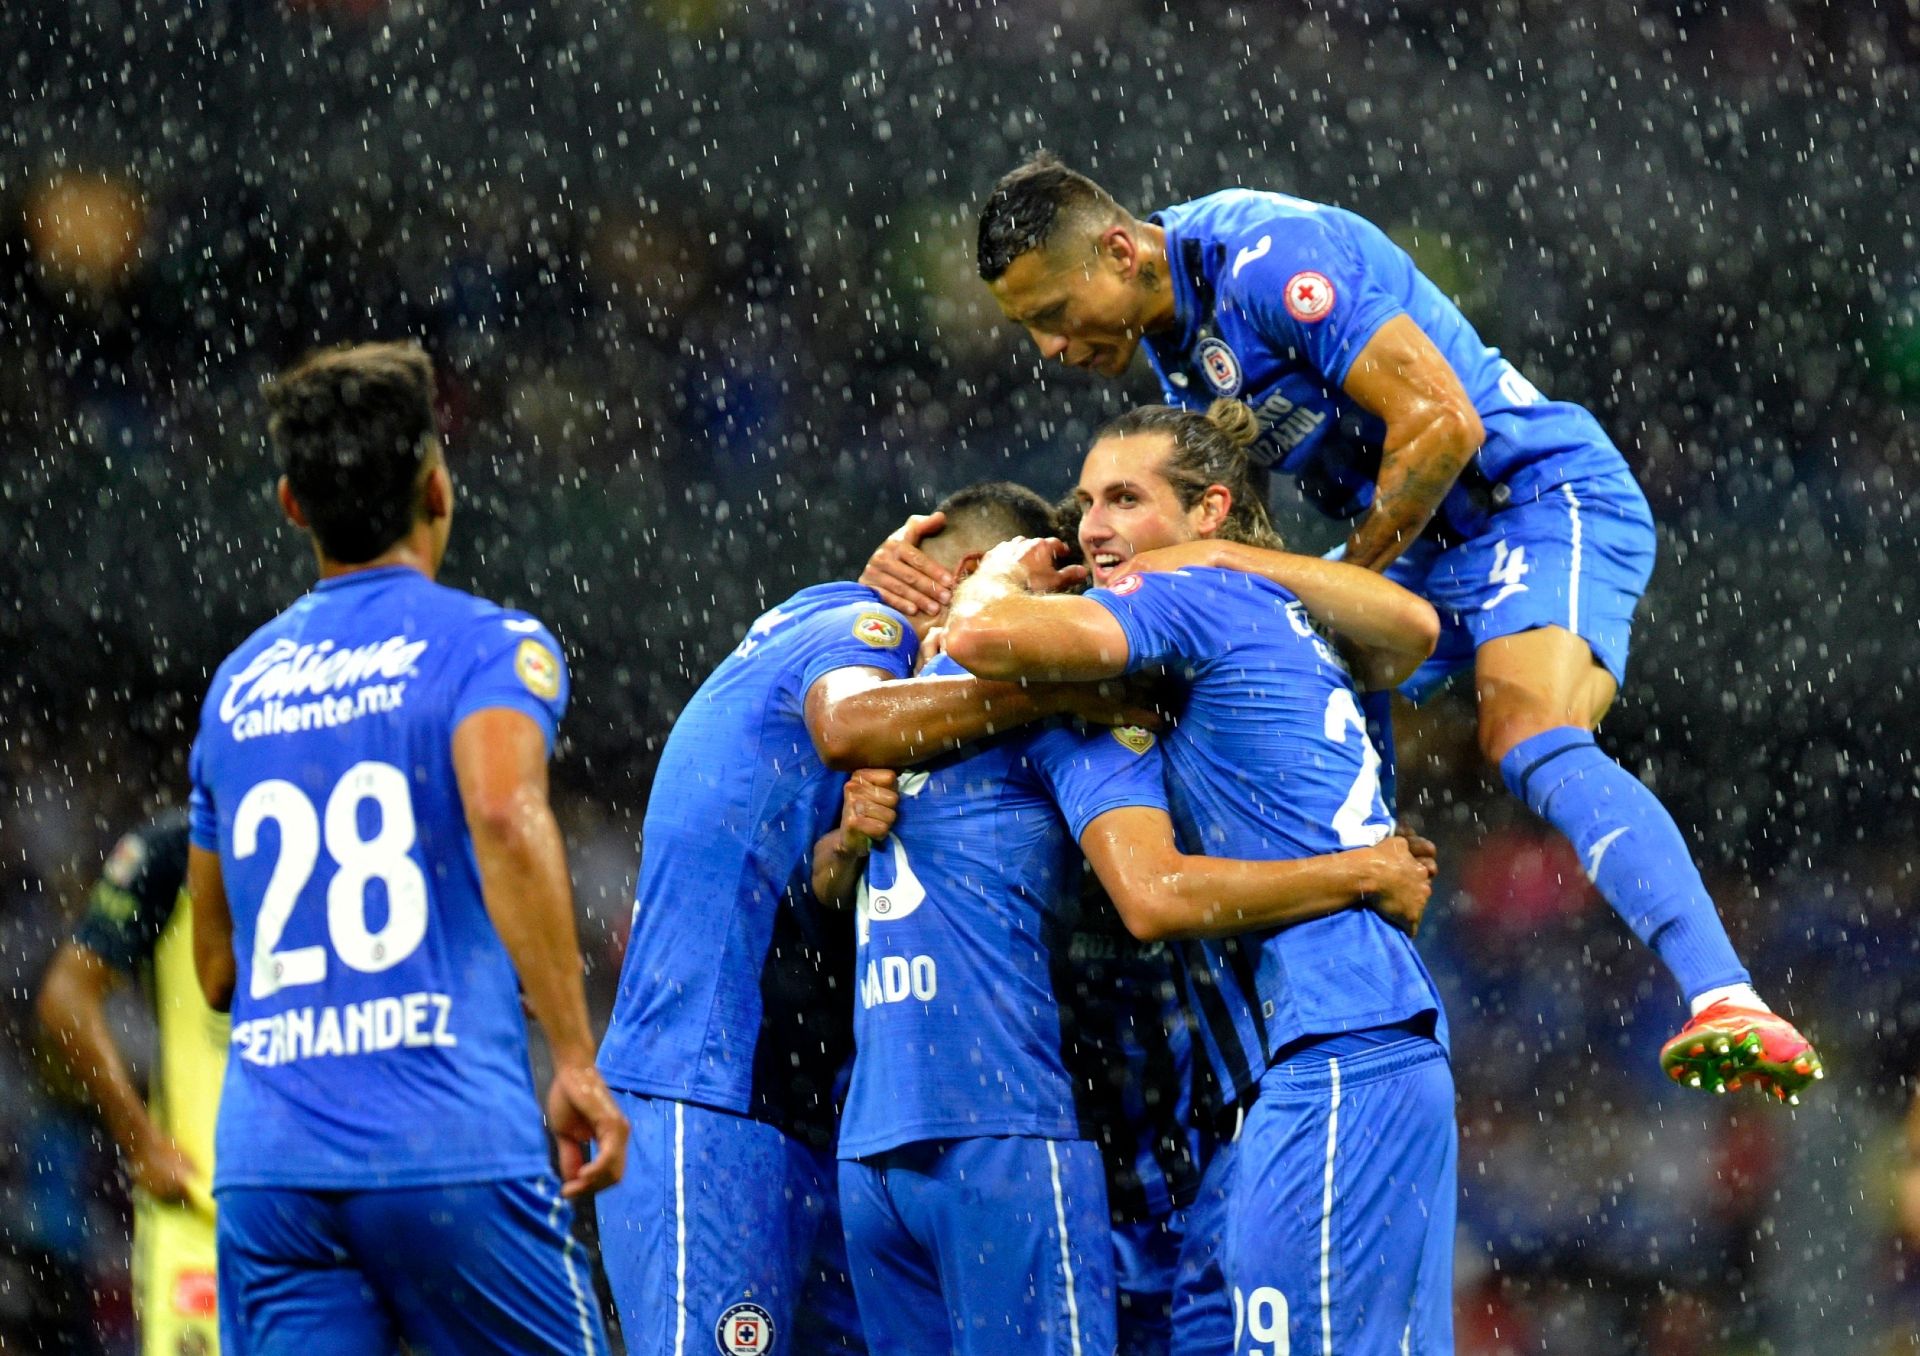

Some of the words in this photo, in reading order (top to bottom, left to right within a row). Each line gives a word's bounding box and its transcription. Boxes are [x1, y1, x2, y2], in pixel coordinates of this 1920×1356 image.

[1271, 406, 1327, 452] AZUL
[1488, 539, 1530, 585] 4
[219, 636, 428, 723] Caliente
[232, 681, 406, 742] caliente.mx
[233, 761, 428, 1000] 28
